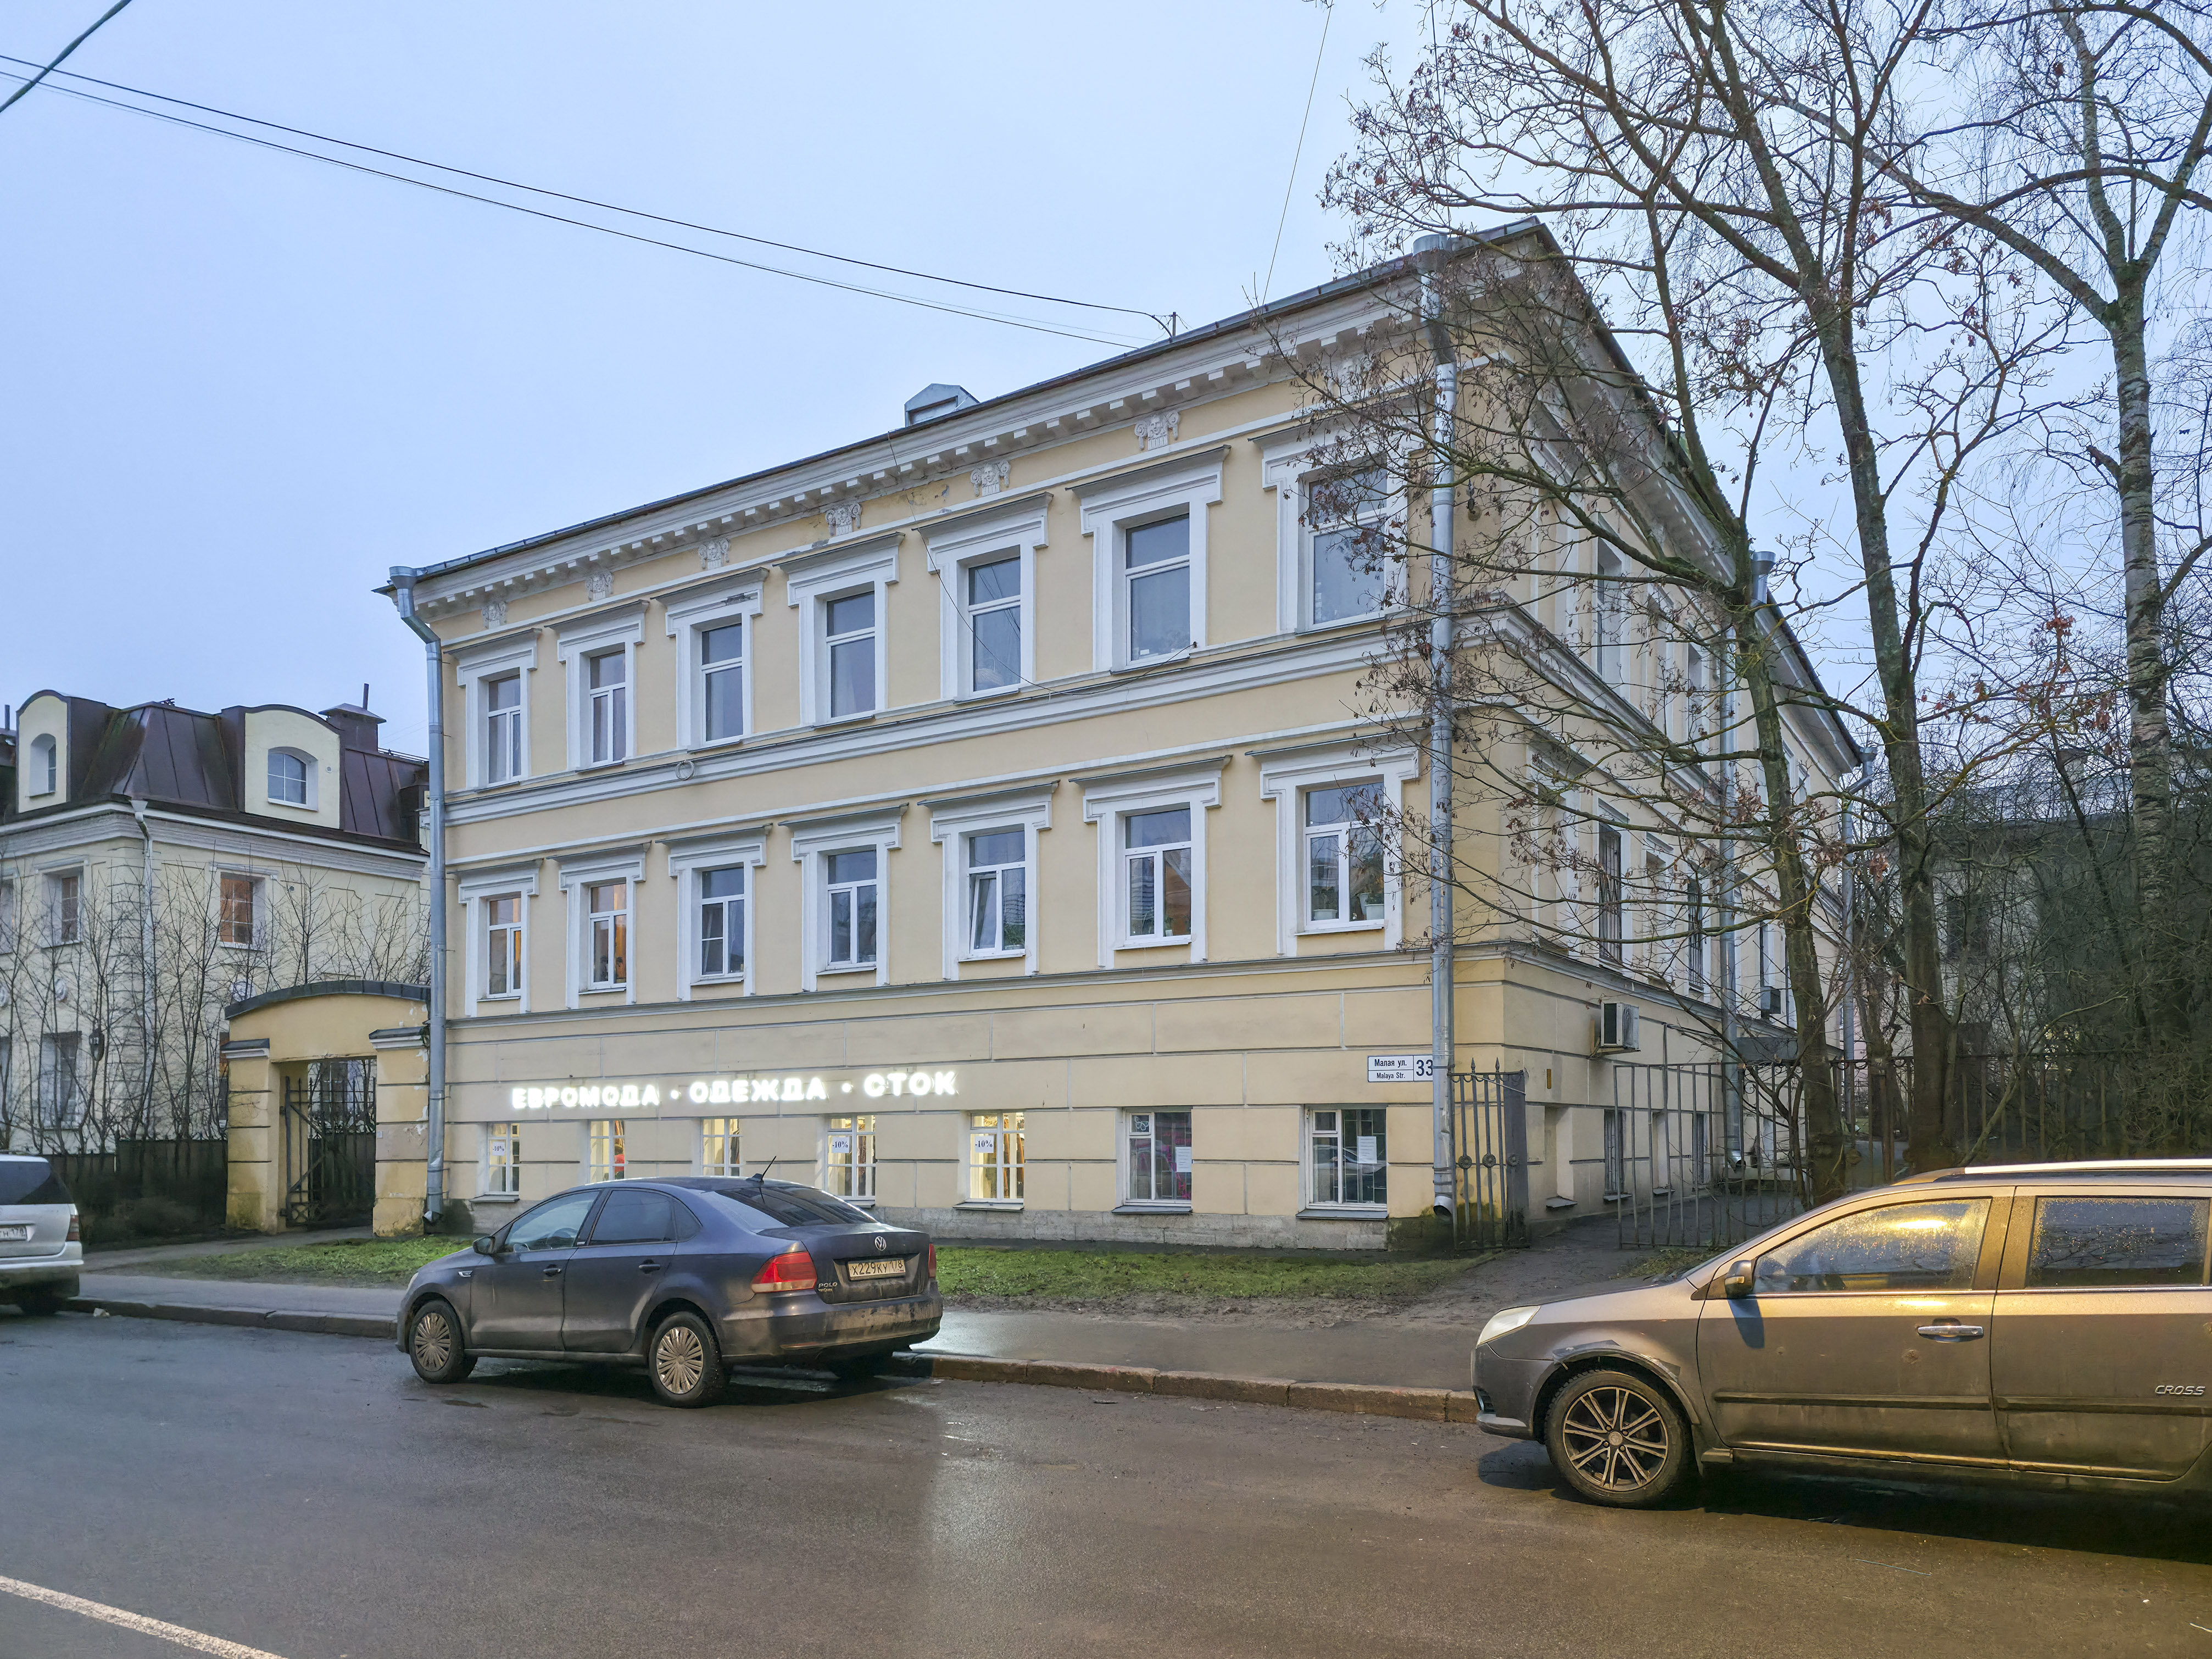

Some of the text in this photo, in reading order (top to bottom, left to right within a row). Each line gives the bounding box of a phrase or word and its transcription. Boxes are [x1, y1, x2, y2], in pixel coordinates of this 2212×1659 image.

[1374, 1059, 1407, 1068] Малая ул.
[1416, 1059, 1433, 1077] 33
[512, 1071, 959, 1109] ЕВРОМОДА ОДЕЖДА СТОК
[2155, 1385, 2205, 1395] CROSS
